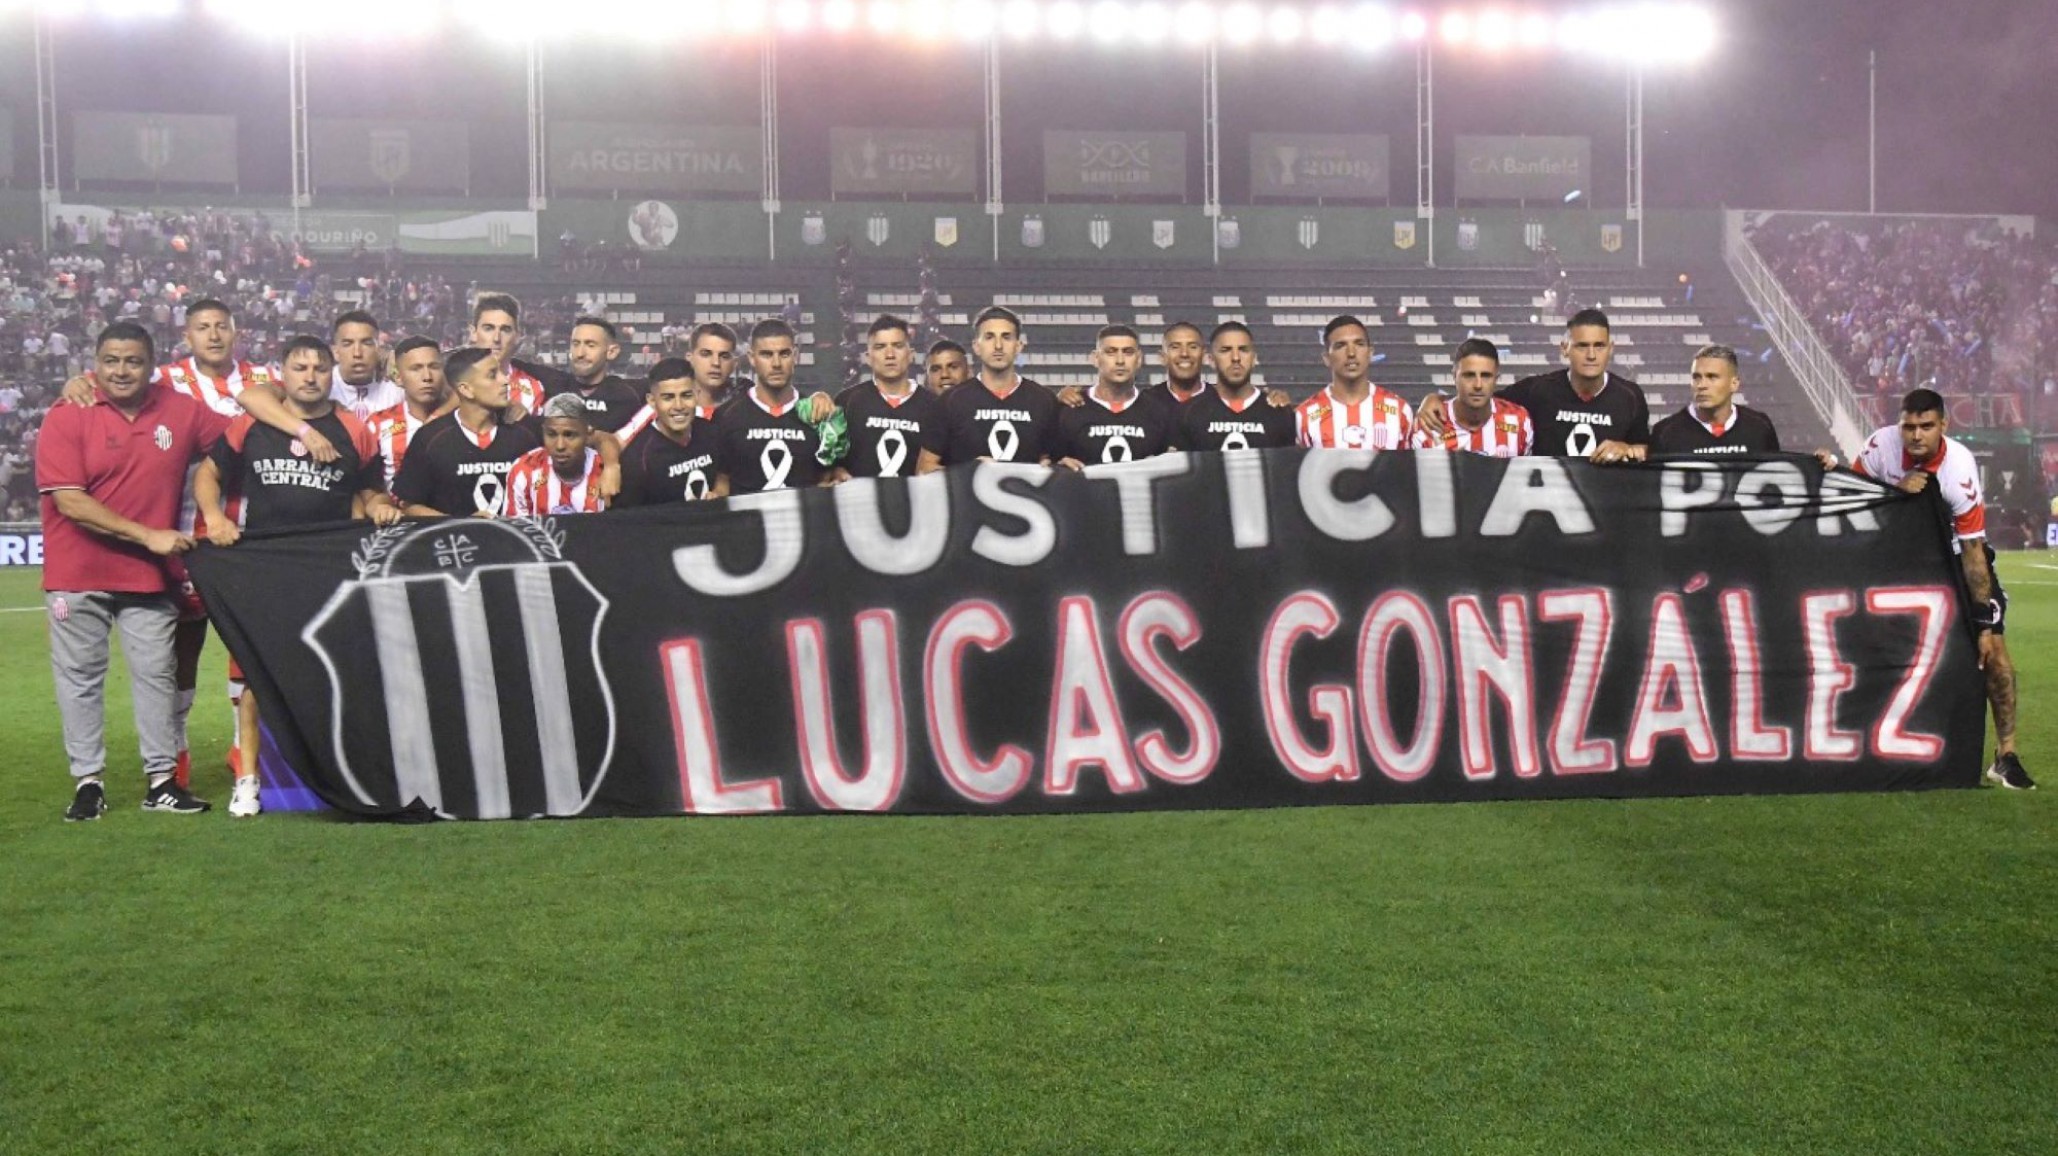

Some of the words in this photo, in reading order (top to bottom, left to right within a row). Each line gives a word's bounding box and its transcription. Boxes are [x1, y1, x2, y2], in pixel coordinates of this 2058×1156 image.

[569, 149, 744, 173] ARGENTINA
[1504, 156, 1579, 173] Banfield
[974, 409, 1031, 422] JUSTICIA
[1556, 410, 1613, 426] JUSTICIA
[866, 416, 920, 432] JUSTICIA
[1088, 425, 1145, 438] JUSTICIA
[1208, 422, 1265, 434] JUSTICIA
[747, 428, 806, 441] JUSTICIA
[253, 459, 345, 483] BARRACAS
[457, 463, 512, 476] JUSTICIA
[668, 454, 713, 477] JUSTICIA
[261, 472, 330, 492] CENTRAL
[672, 449, 1595, 596] JUSTICIA
[1660, 461, 1892, 536] POR
[659, 591, 1222, 813] LUCAS
[1259, 572, 1954, 782] GONZÁLEZ
